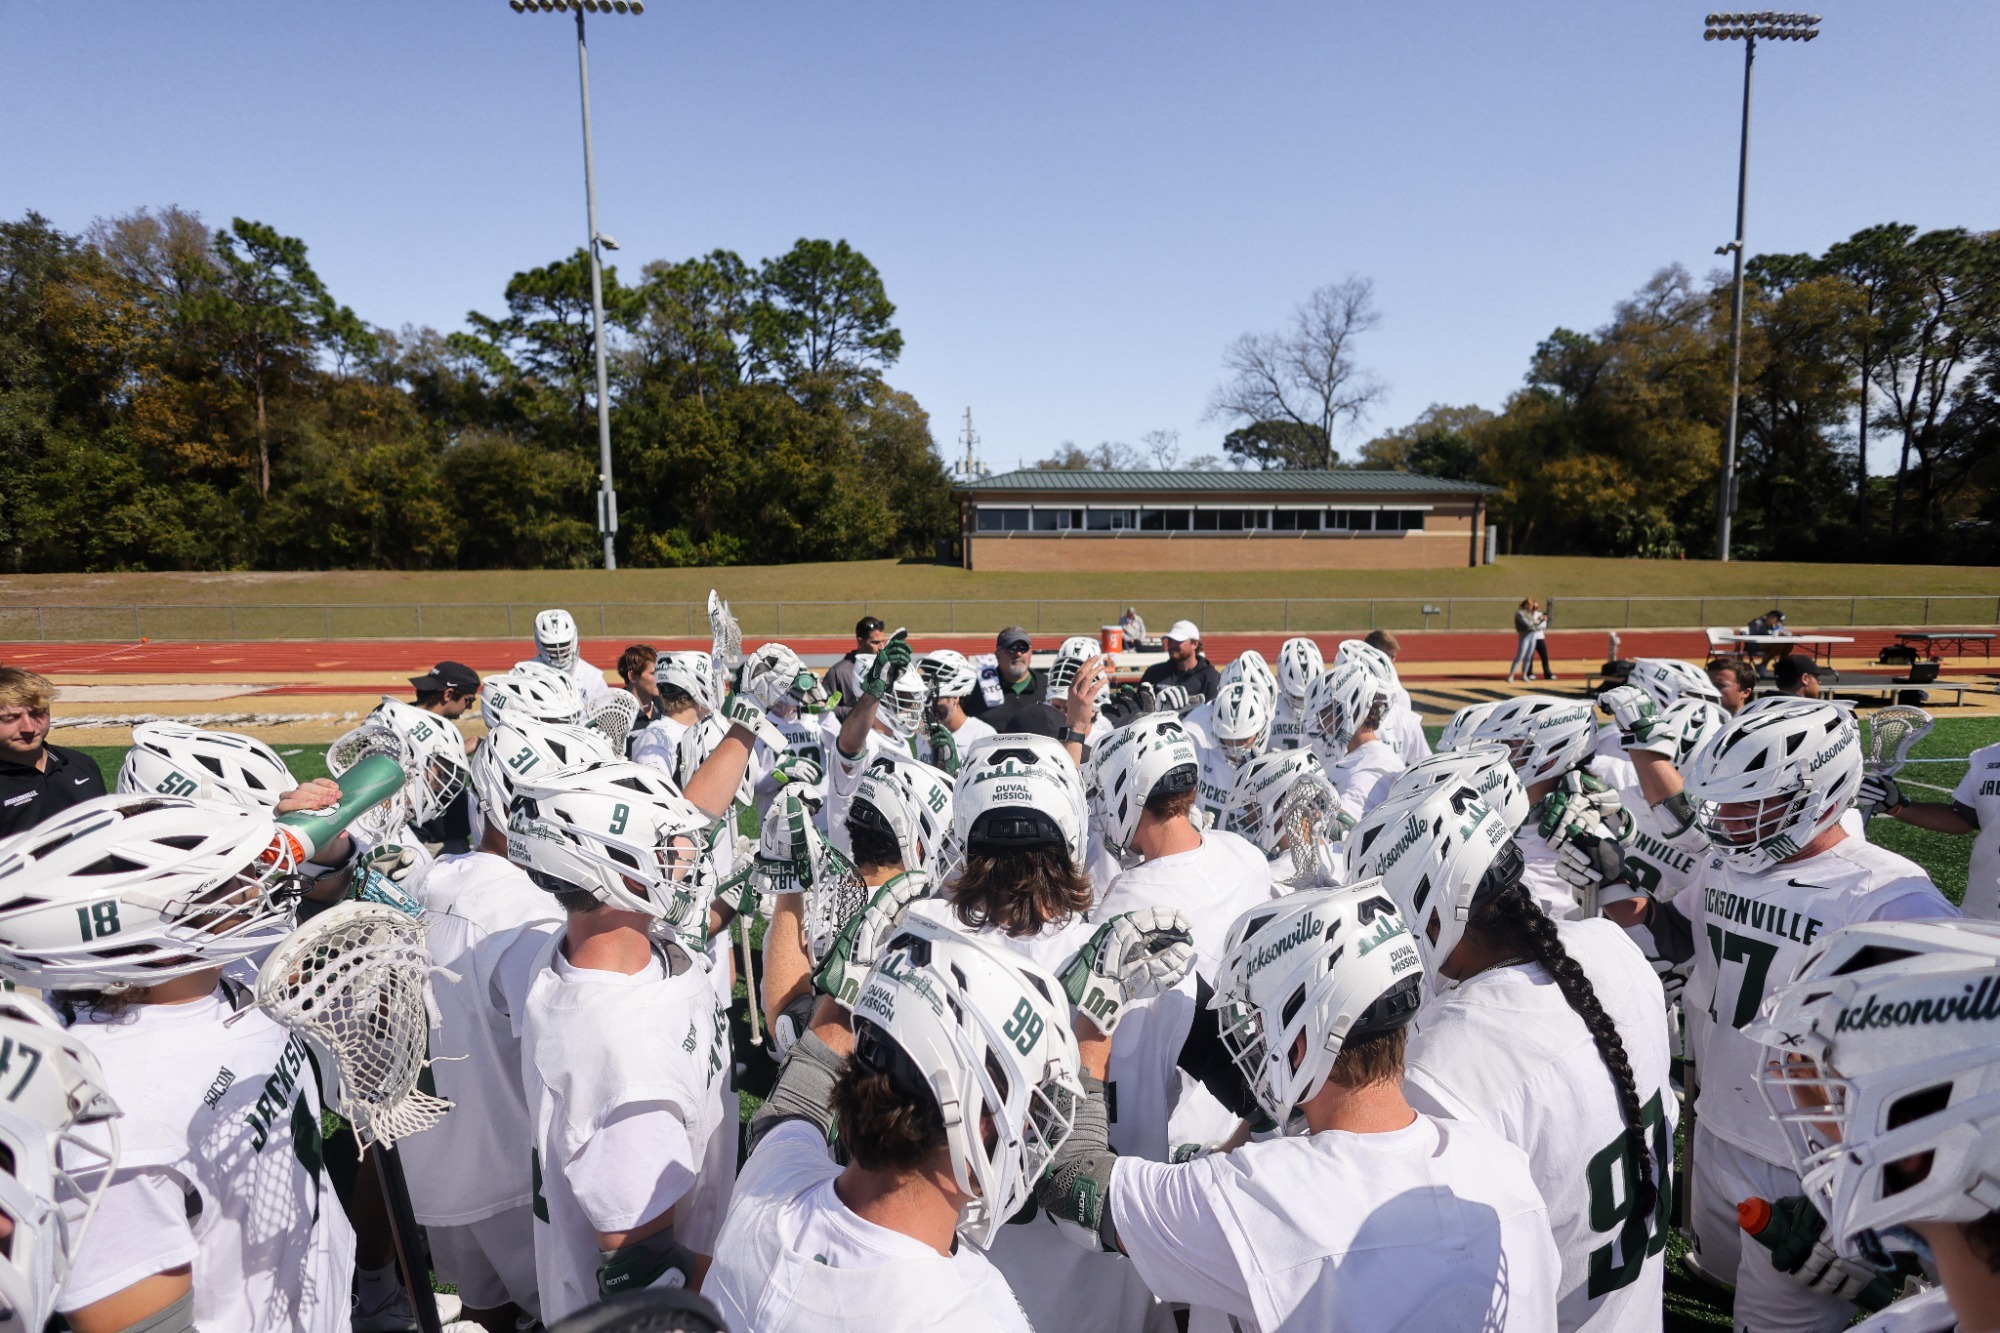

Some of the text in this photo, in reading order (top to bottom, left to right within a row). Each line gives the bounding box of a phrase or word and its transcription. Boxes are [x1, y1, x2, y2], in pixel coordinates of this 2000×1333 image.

[1654, 667, 1669, 681] 13
[490, 692, 507, 709] 20
[411, 721, 433, 742] 39
[508, 747, 540, 775] 31
[995, 784, 1029, 793] DUVAL
[1255, 758, 1295, 794] acksonville
[928, 784, 948, 815] 46
[992, 792, 1033, 802] MISSION
[608, 803, 630, 835] 9
[1485, 819, 1503, 838] DUVAL
[1489, 827, 1509, 848] MISSION
[1633, 830, 1696, 875] NVILLE
[76, 900, 121, 942] 18
[1247, 911, 1324, 980] acksonville
[1389, 946, 1415, 962] DUVAL
[1391, 955, 1420, 975] MISSION
[867, 984, 896, 1007] DUVAL
[1003, 996, 1044, 1056] 99
[204, 1065, 237, 1111] SOCON
[244, 1031, 306, 1154] JACKSO
[1078, 1190, 1086, 1223] ROME
[606, 1273, 630, 1286] ROME
